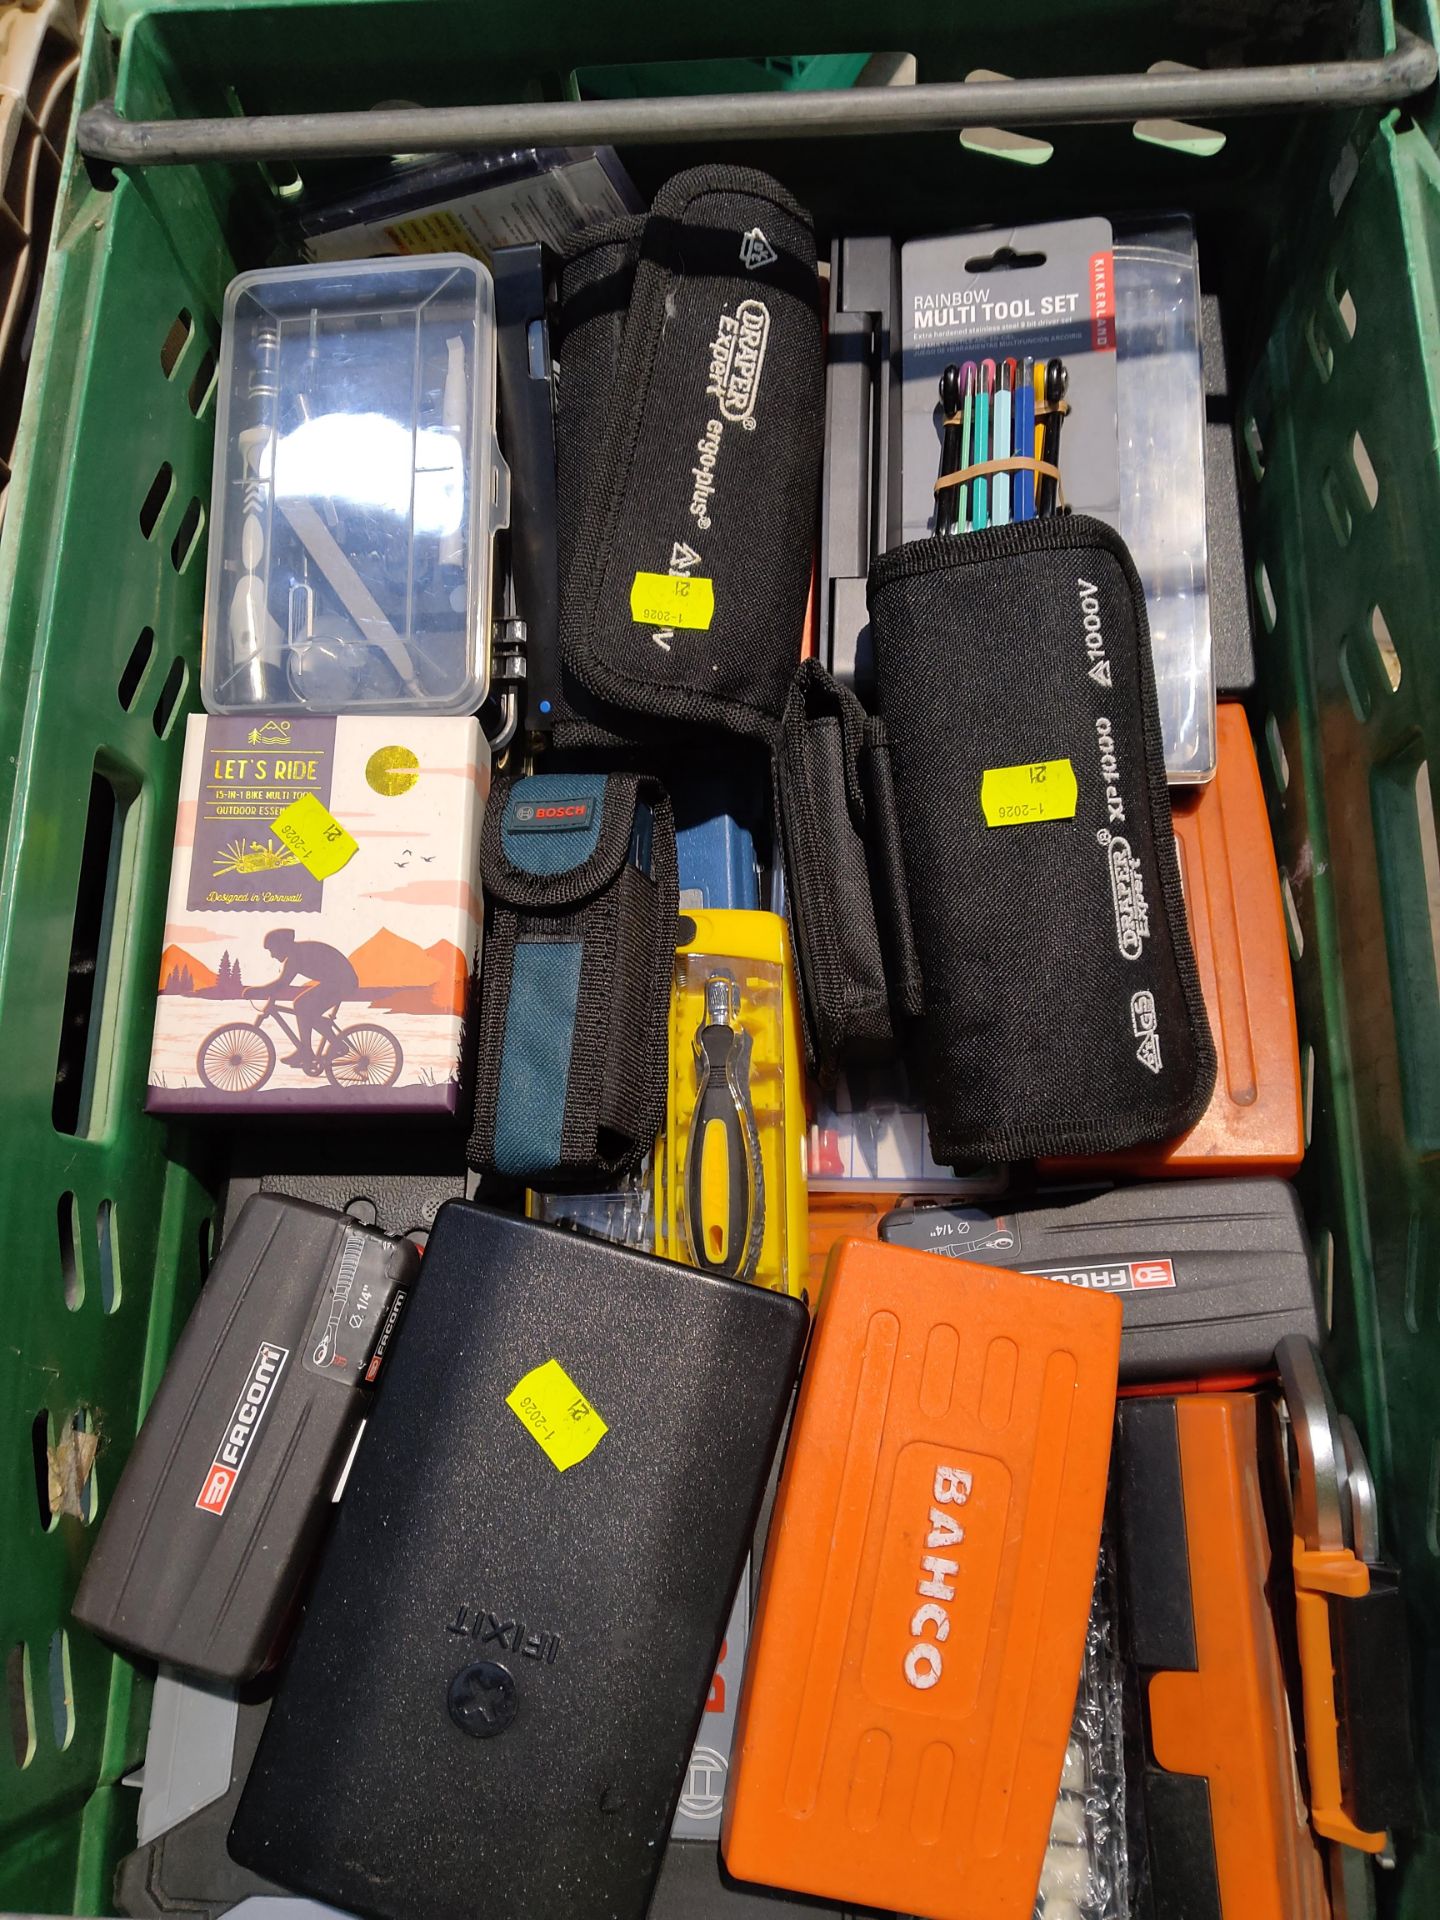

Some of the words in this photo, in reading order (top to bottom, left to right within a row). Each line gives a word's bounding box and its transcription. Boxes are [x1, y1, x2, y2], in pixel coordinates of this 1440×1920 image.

[914, 288, 990, 310] RAINBOW
[914, 305, 976, 329] MULTI
[981, 298, 1036, 322] TOOL
[1041, 293, 1080, 315] SET
[1094, 258, 1108, 347] KIKKERLAND
[913, 332, 933, 341] Extra
[933, 328, 968, 339] hardened
[969, 325, 1001, 335] stainless
[1002, 321, 1020, 330] steel
[1038, 318, 1060, 327] driver
[1060, 316, 1073, 325] set
[706, 315, 739, 397] Expert
[675, 581, 691, 597] 21
[643, 608, 684, 624] 1-2026
[1078, 578, 1105, 661] 1000V
[214, 759, 268, 780] LET'S
[274, 760, 320, 780] RIDE
[1029, 766, 1047, 784] 21
[1095, 717, 1126, 822] XP1000
[216, 790, 243, 799] 15-IN-1
[246, 790, 263, 800] BIKE
[266, 791, 290, 800] MULTI
[216, 806, 257, 815] OUTDOOR
[536, 804, 586, 819] BOSCH
[999, 803, 1045, 818] 1-2026
[281, 824, 313, 859] 1-2026
[323, 823, 343, 842] 21
[206, 891, 249, 904] Designed
[250, 892, 260, 902] in
[262, 891, 303, 903] Cornwall
[376, 1291, 405, 1356] FACOM
[222, 1346, 281, 1466] FACOM
[567, 1398, 590, 1422] 21
[520, 1397, 556, 1440] 1-2026
[904, 1464, 973, 1690] BAHCO
